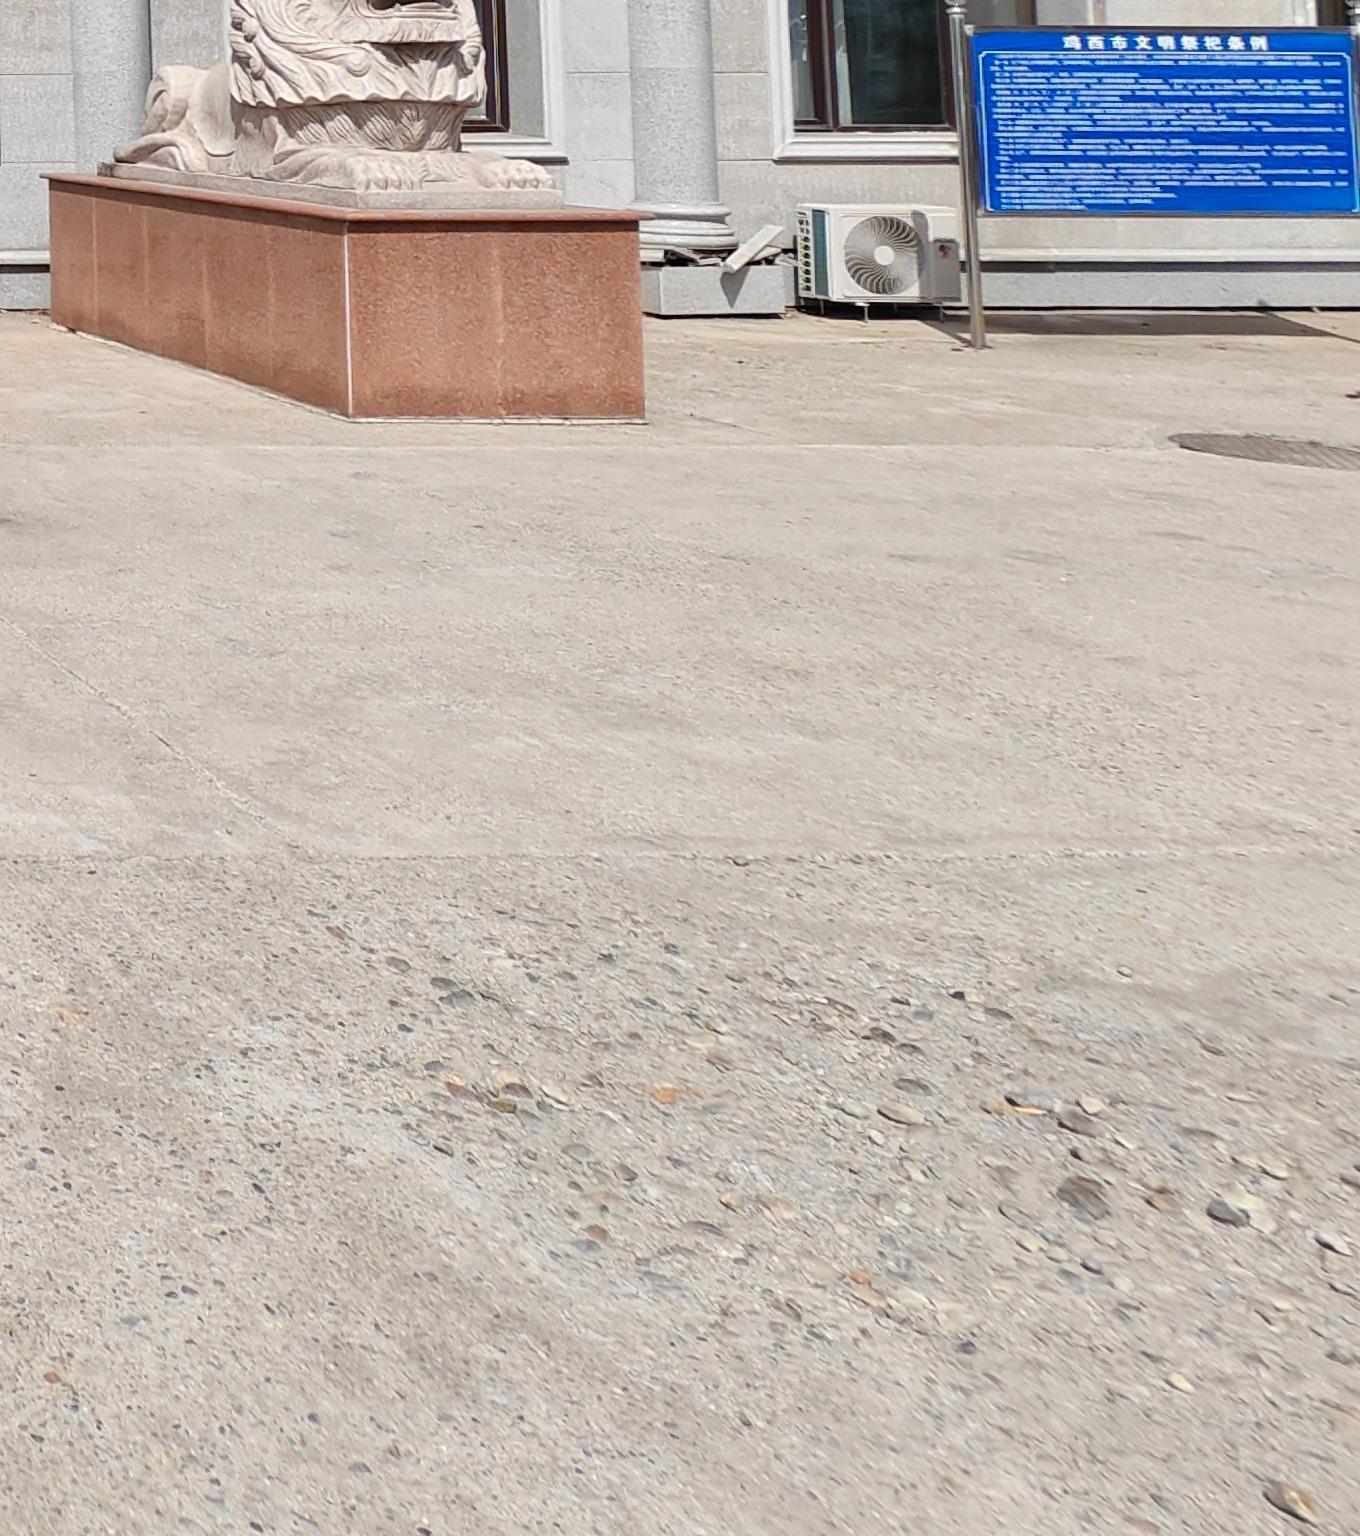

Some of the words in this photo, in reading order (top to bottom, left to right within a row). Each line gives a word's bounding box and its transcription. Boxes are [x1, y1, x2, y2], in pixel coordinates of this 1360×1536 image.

[1062, 35, 1269, 51] 鸡西市文明祭祀条例
